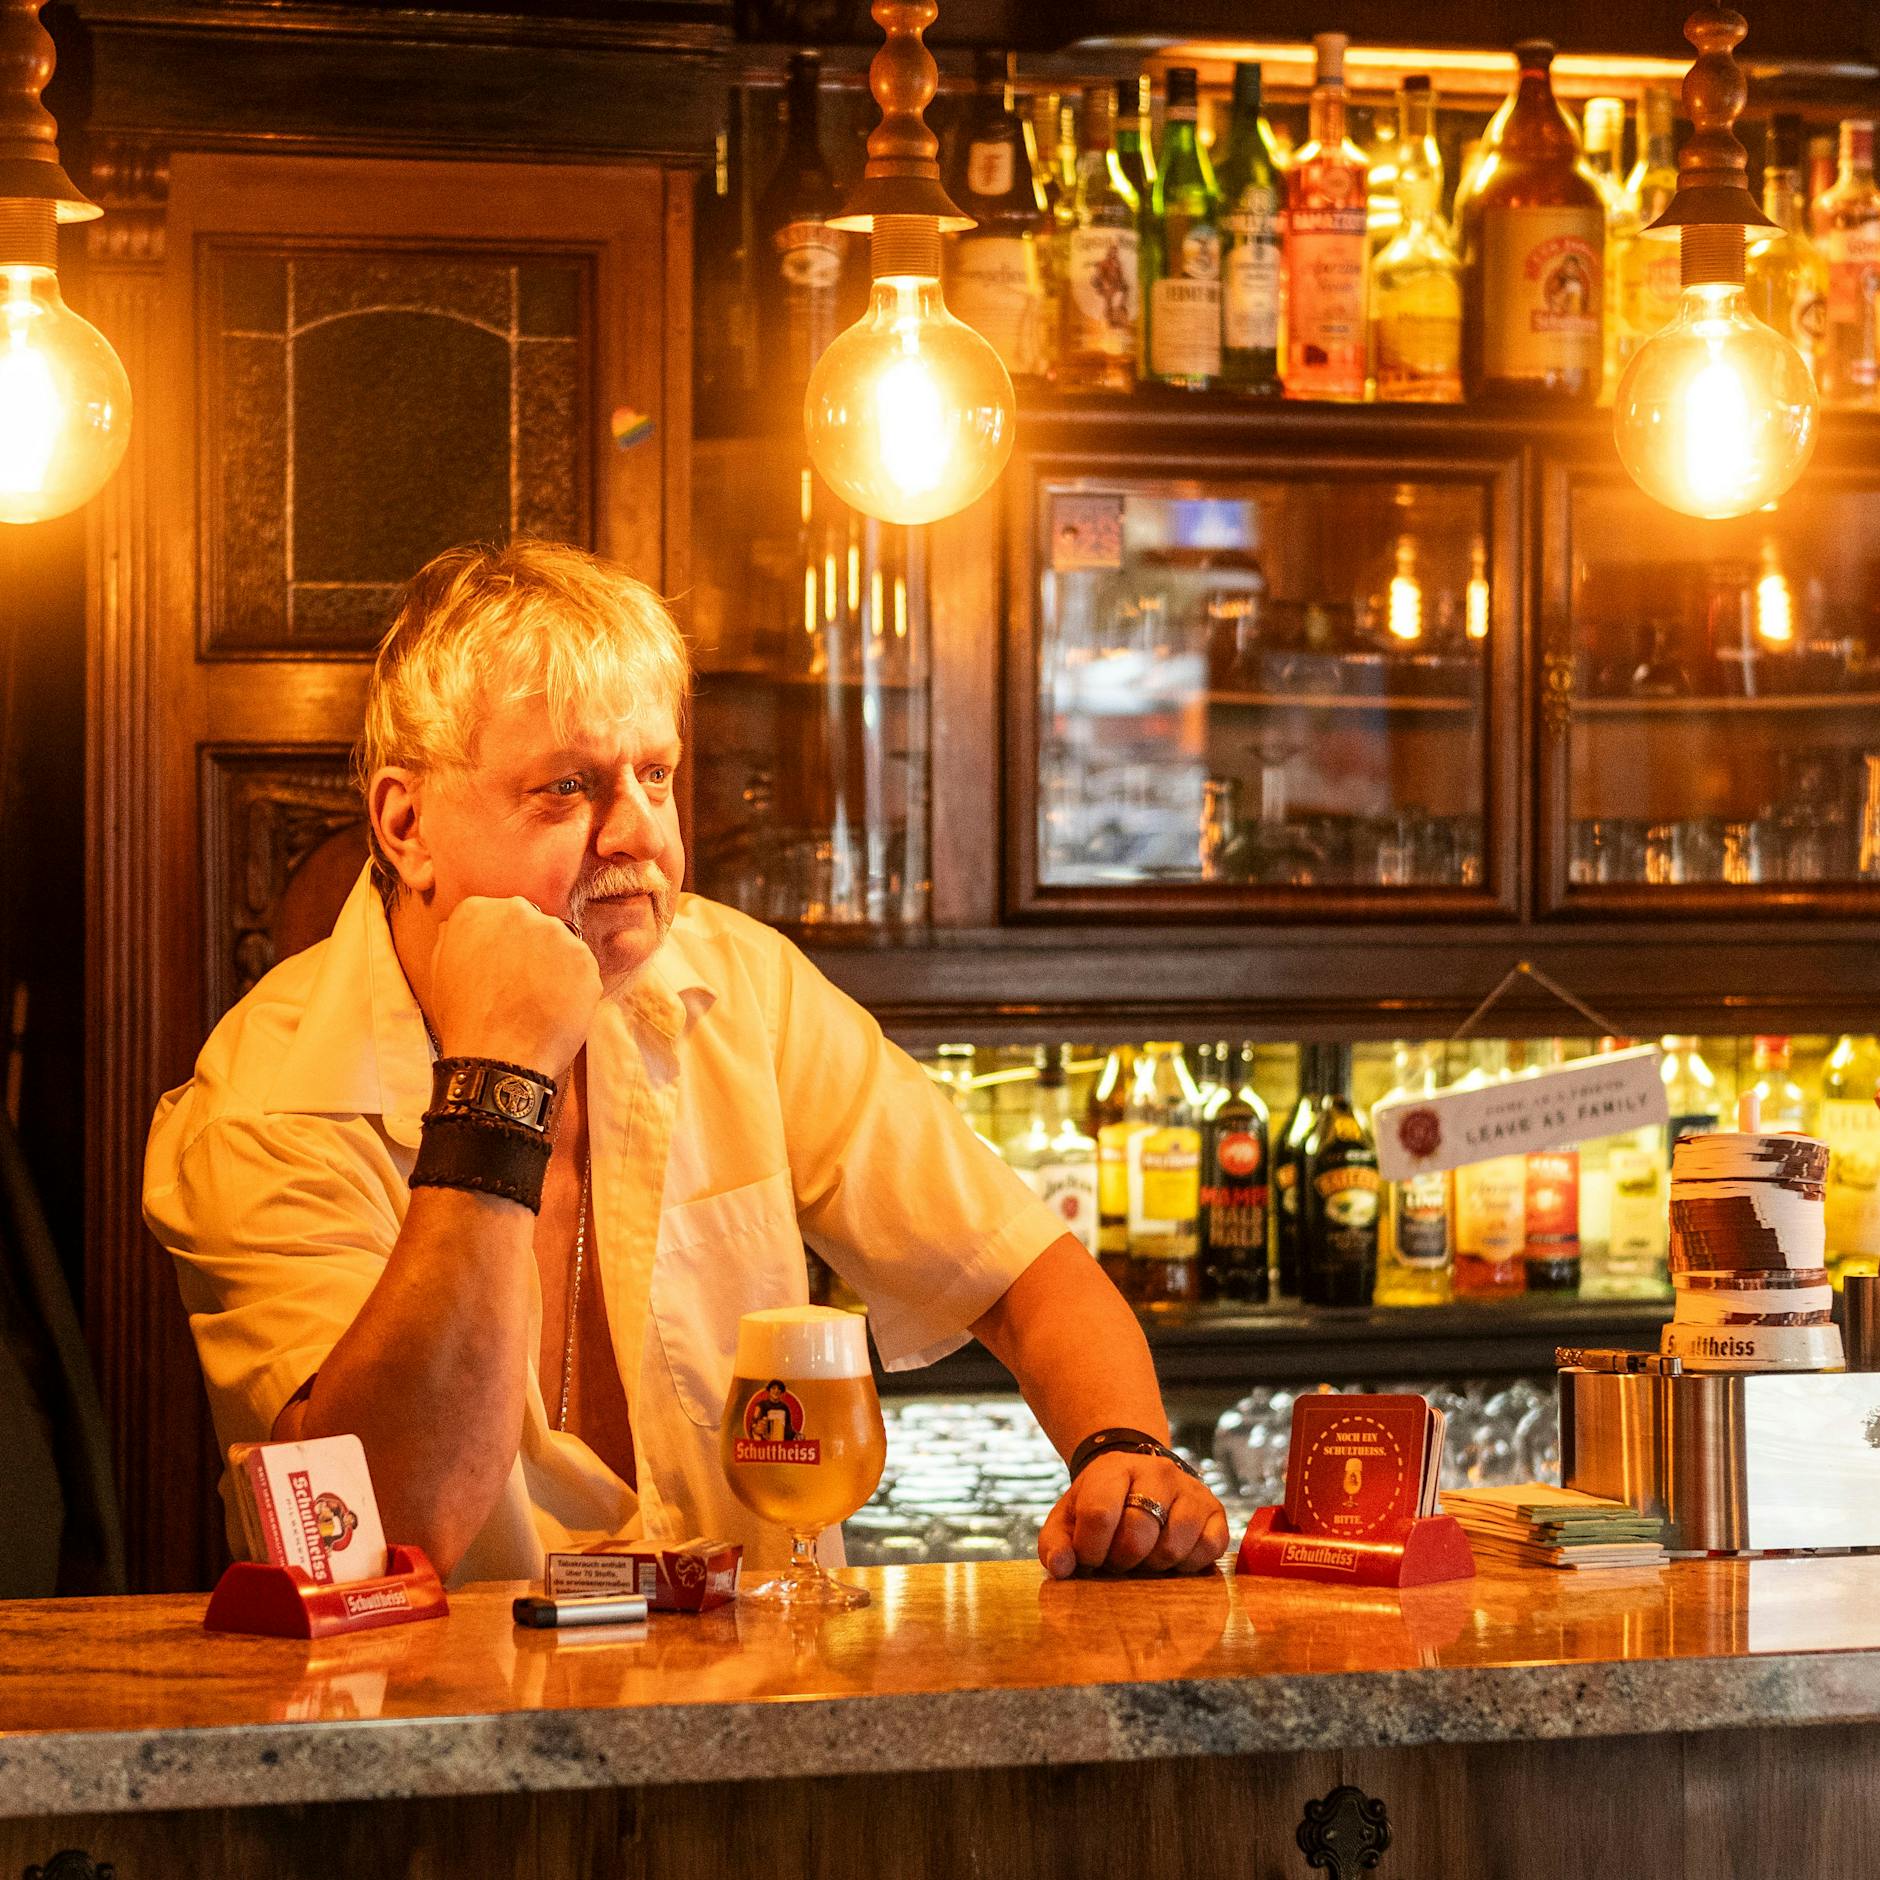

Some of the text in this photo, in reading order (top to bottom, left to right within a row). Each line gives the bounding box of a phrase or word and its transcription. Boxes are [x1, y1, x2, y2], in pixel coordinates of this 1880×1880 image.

[1465, 1091, 1649, 1146] LEAVE AS FAMILY
[1667, 1334, 1755, 1357] Sltheiss
[1336, 1432, 1378, 1442] NOCH EIN
[736, 1442, 816, 1461] Schultheiss
[292, 1476, 328, 1581] Schultheiss
[1334, 1514, 1364, 1525] BITTE.
[558, 1559, 600, 1568] Tabakrauch
[1286, 1546, 1354, 1566] Schultheiss
[584, 1569, 593, 1577] 70
[349, 1589, 407, 1613] Schultheiss
